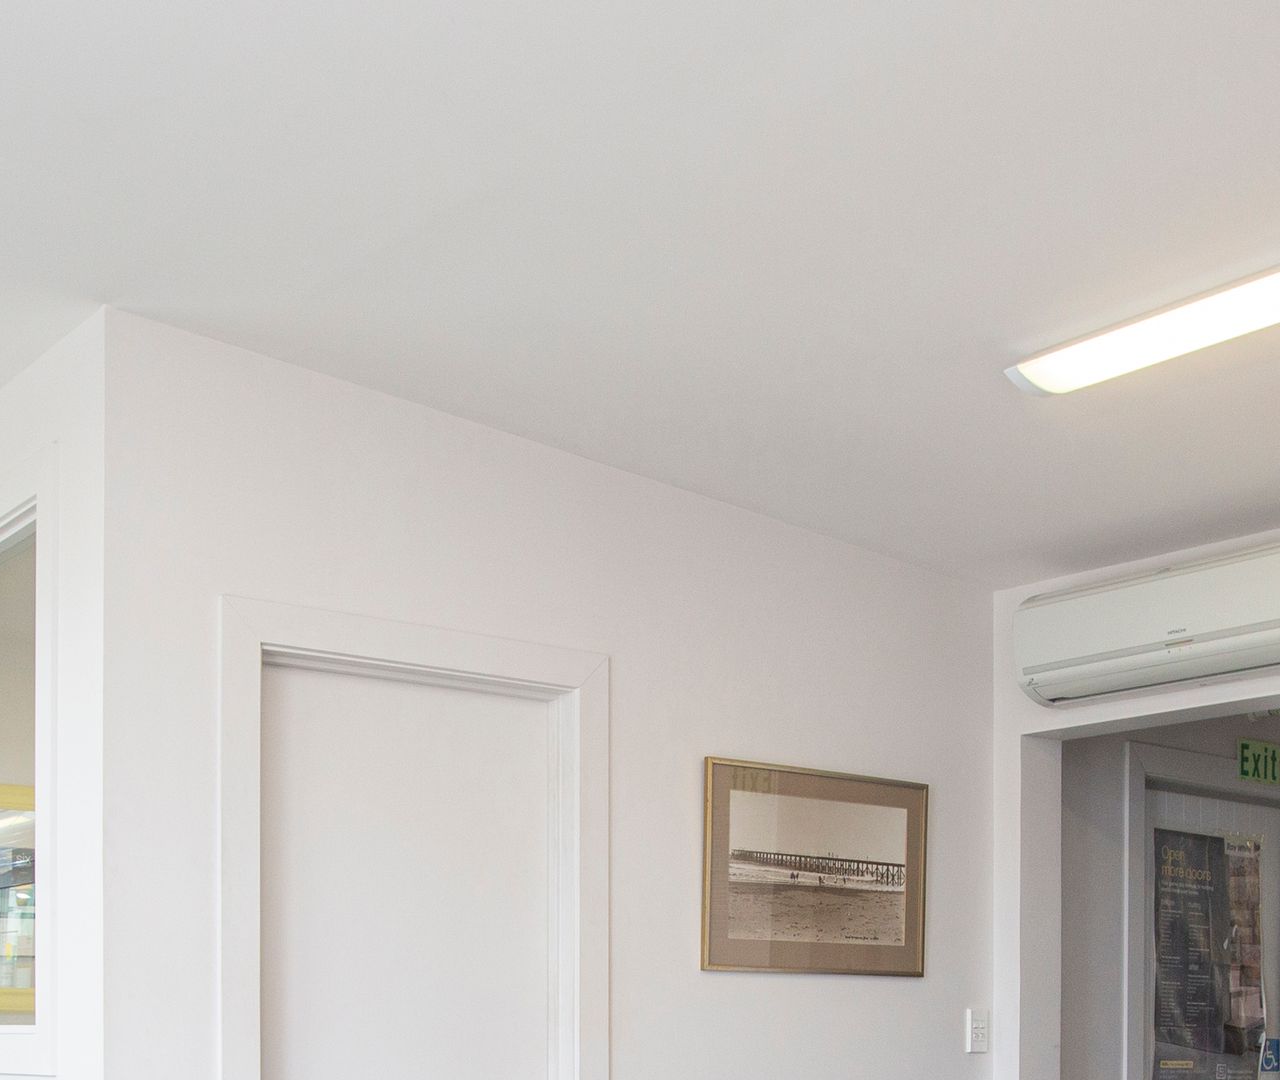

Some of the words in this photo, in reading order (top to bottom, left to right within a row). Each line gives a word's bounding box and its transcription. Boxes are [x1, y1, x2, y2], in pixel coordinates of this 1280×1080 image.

[1240, 743, 1278, 782] Exit
[1161, 844, 1185, 865] Open
[1161, 865, 1185, 878] more
[1185, 865, 1212, 881] doors
